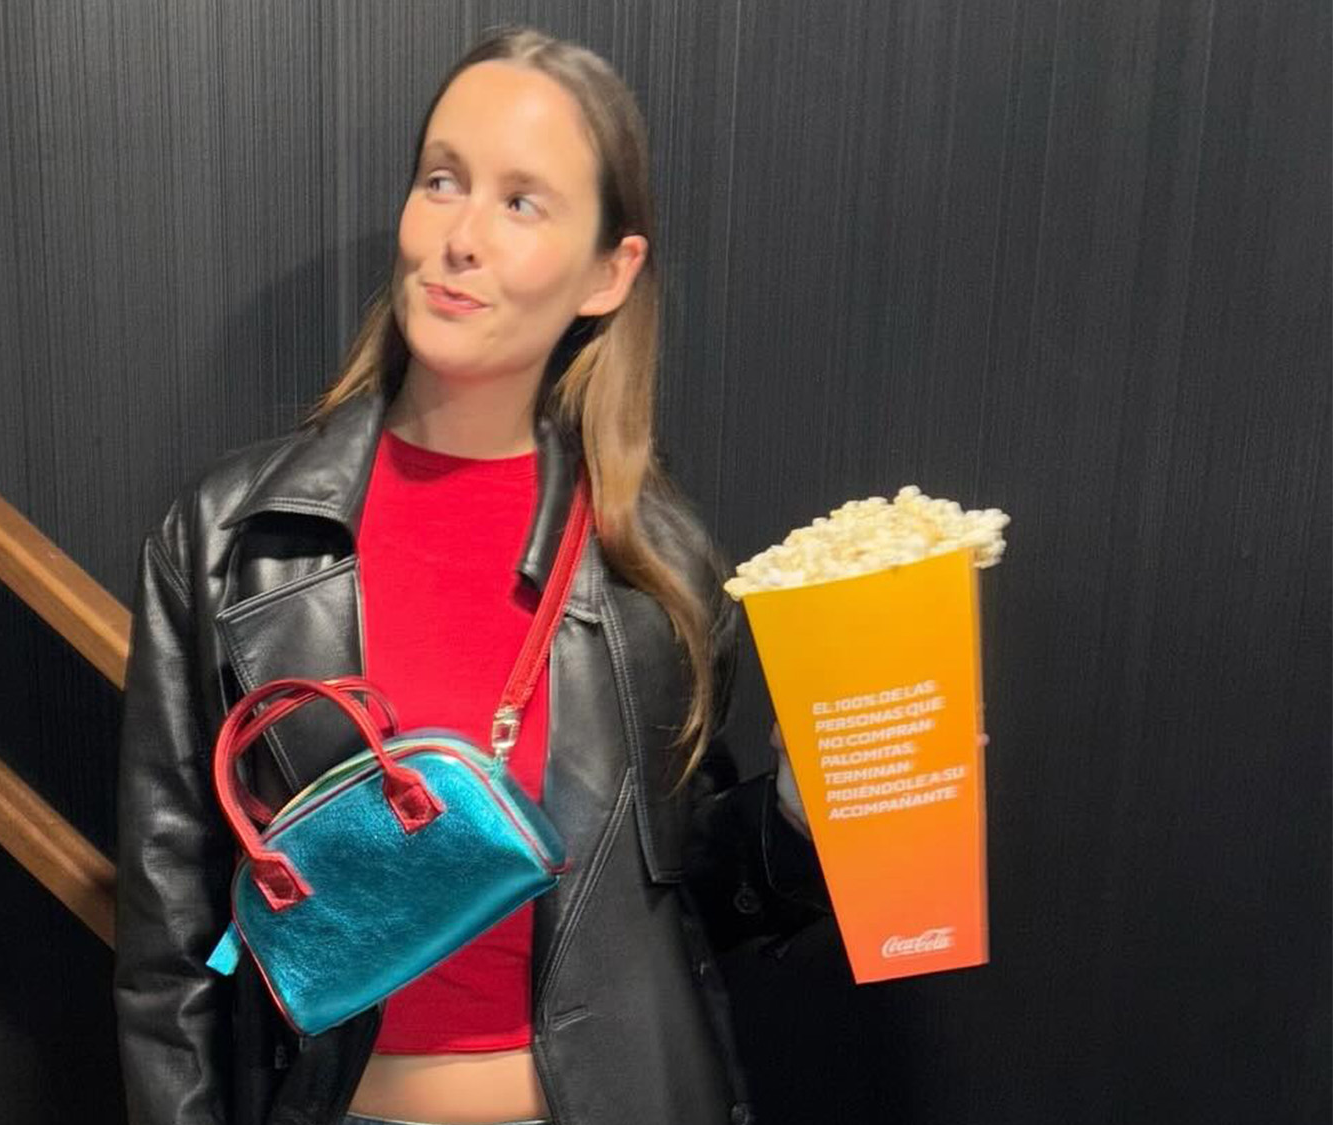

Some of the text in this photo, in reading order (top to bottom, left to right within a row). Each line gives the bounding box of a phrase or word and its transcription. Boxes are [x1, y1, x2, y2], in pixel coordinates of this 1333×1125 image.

[813, 702, 832, 715] EL
[879, 688, 904, 703] DE
[905, 680, 936, 698] LAS
[815, 696, 946, 733] PERSONAS QUE
[818, 718, 935, 751] NO COMPRAN
[821, 741, 915, 768] PALOMITAS
[824, 760, 913, 785] TERMINAN
[881, 926, 955, 958] Coca-Cola
